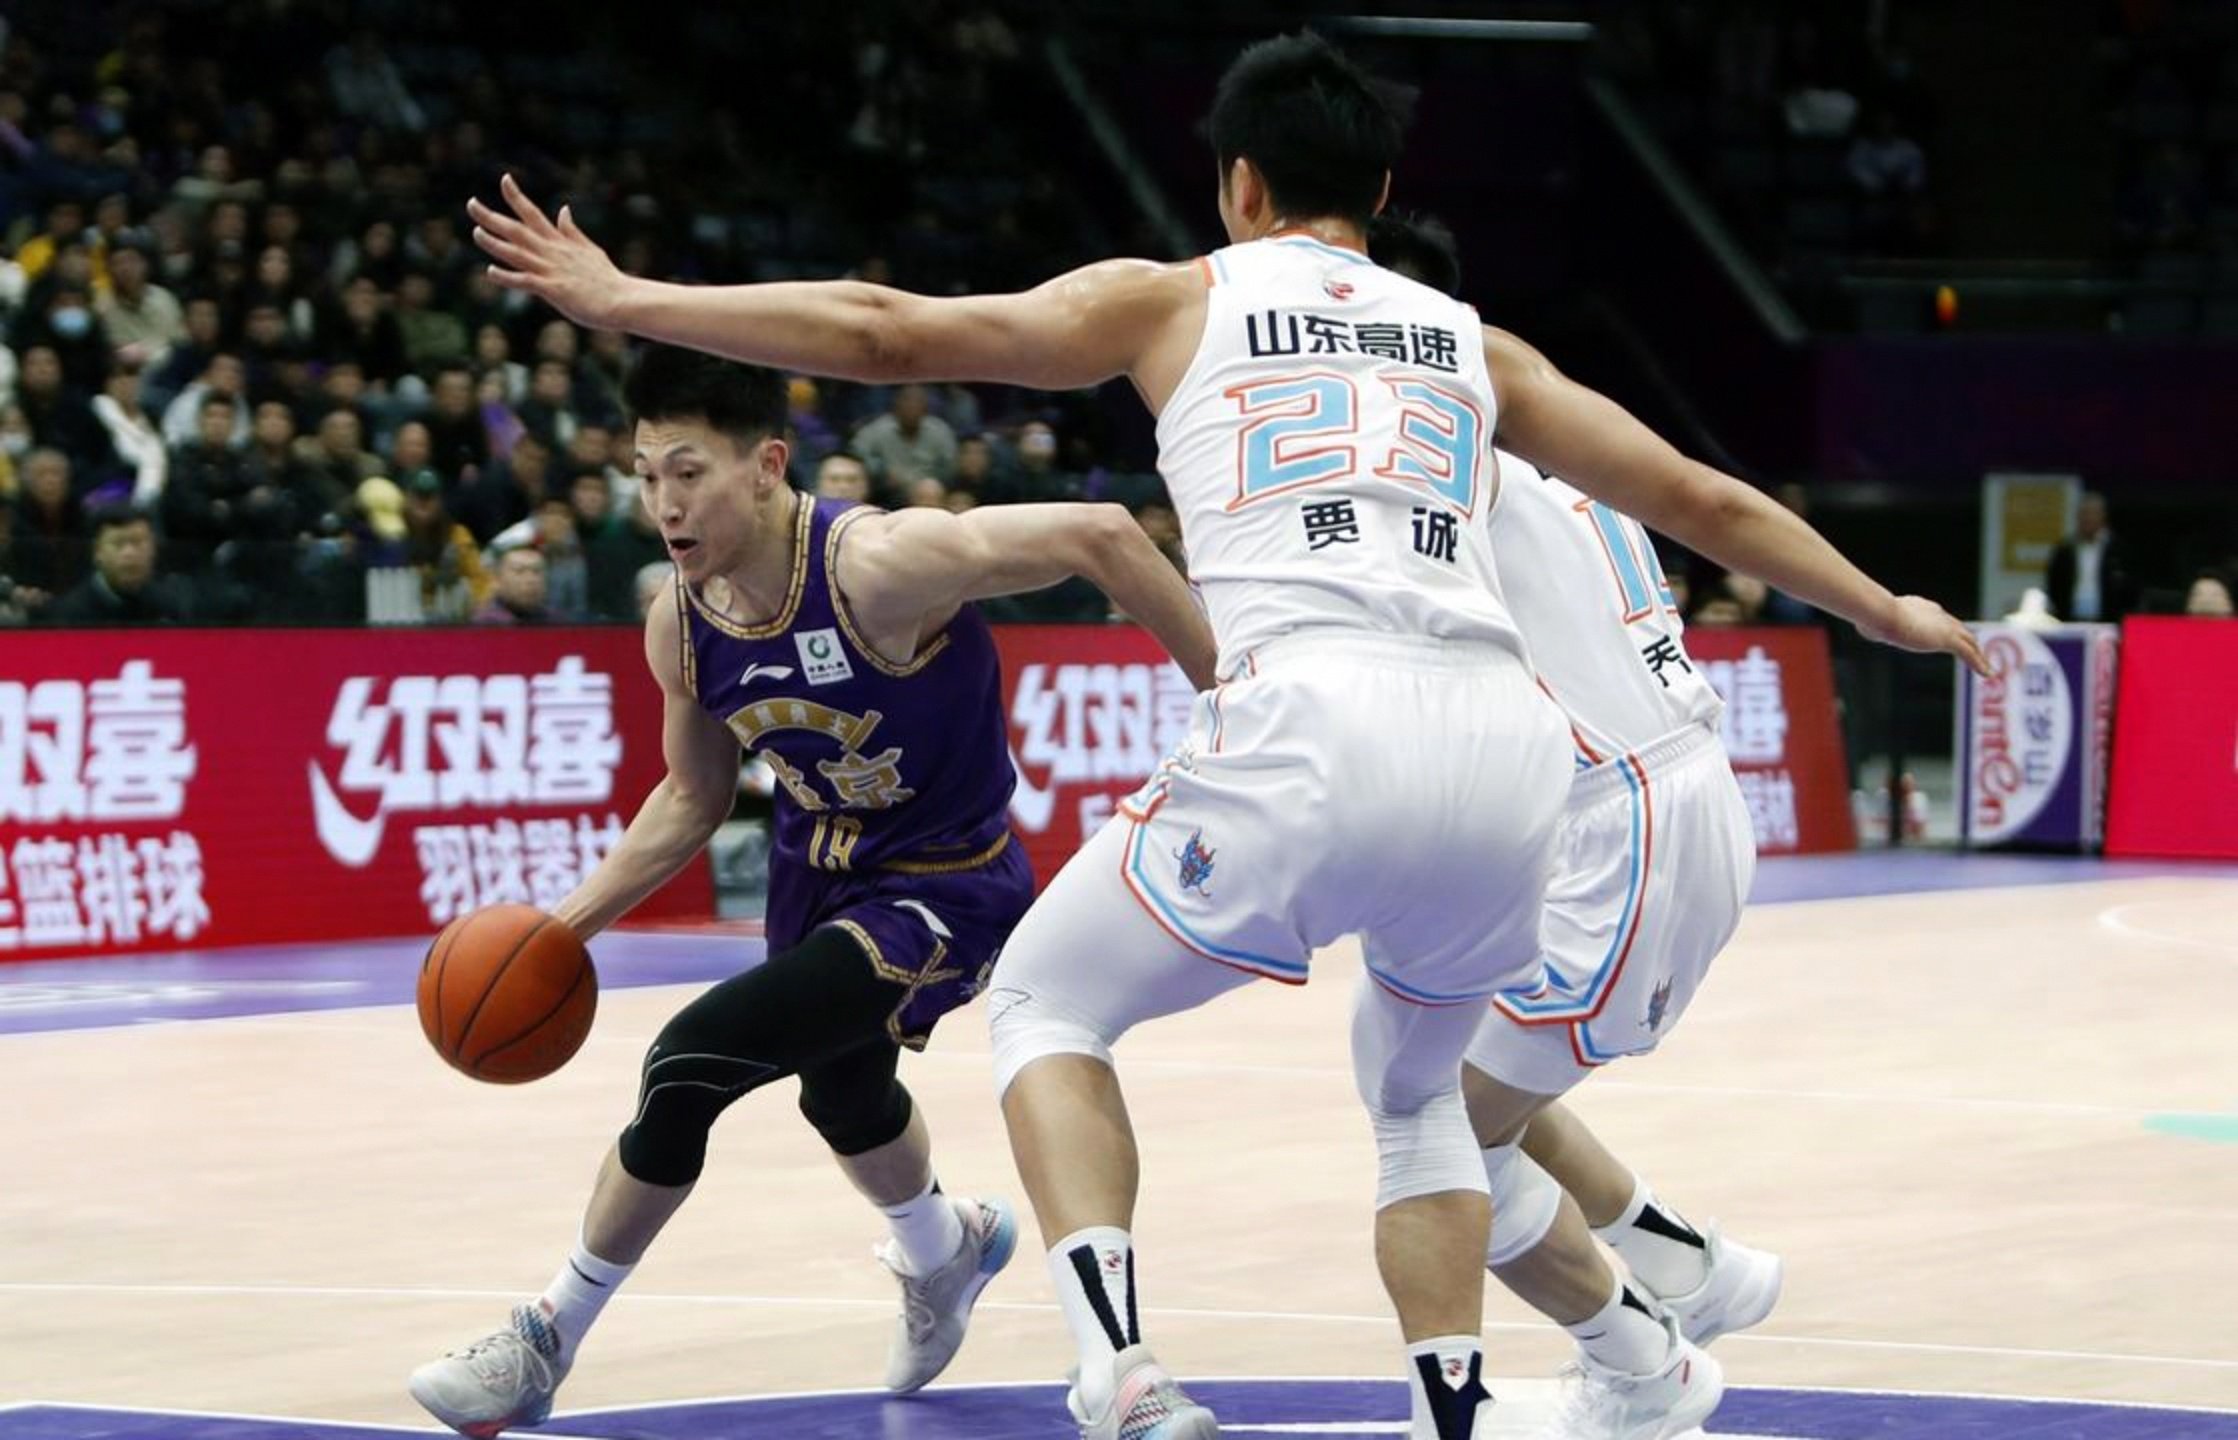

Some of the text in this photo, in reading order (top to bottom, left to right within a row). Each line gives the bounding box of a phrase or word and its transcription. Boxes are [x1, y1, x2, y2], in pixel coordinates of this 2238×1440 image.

[1246, 310, 1459, 373] 山东高速
[1224, 371, 1483, 522] 23
[326, 655, 623, 810] 红双喜
